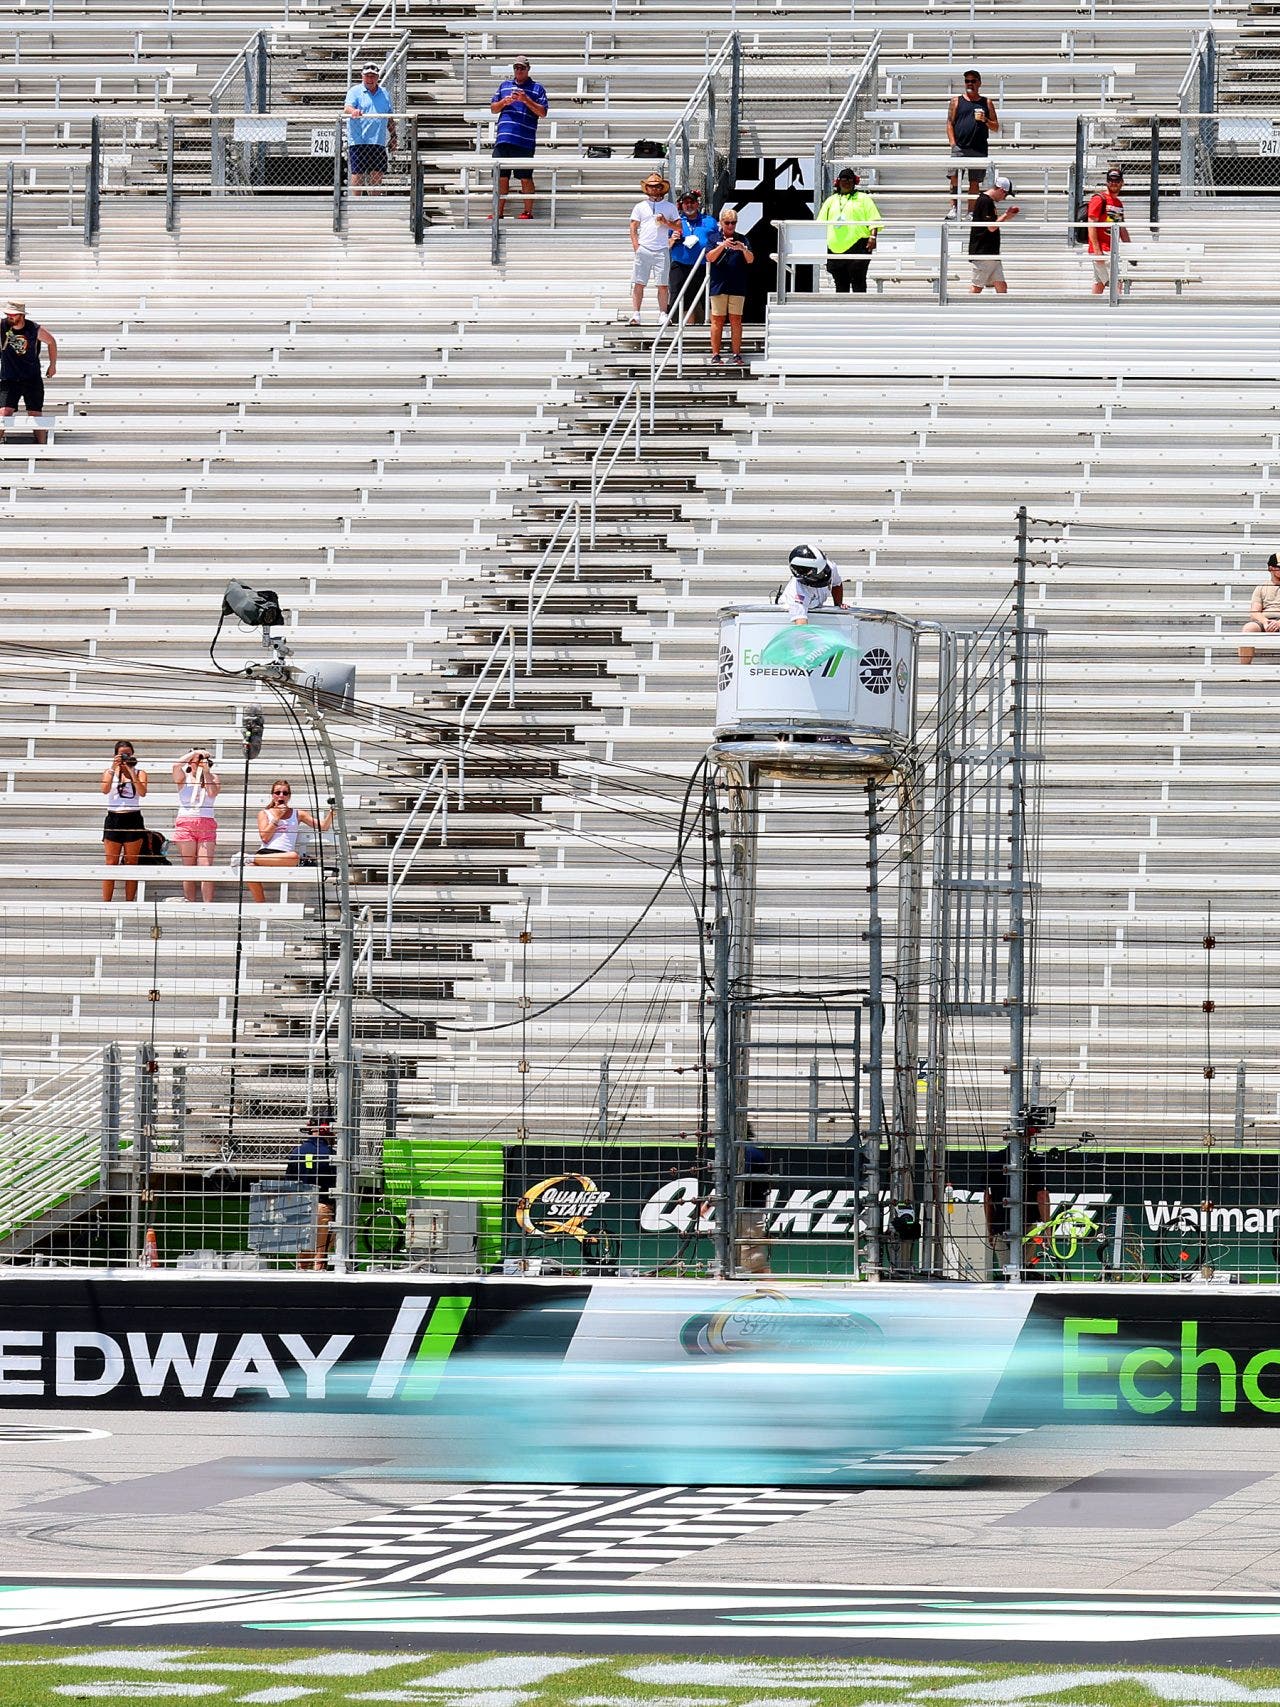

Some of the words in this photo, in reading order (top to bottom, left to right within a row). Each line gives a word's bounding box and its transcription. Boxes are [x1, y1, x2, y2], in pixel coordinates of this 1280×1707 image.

[314, 140, 330, 153] 248
[1261, 140, 1277, 153] 247
[749, 668, 814, 677] SPEEDWAY
[541, 1187, 611, 1204] QUAKER
[546, 1203, 598, 1216] STATE
[0, 1330, 355, 1399] EDWAY
